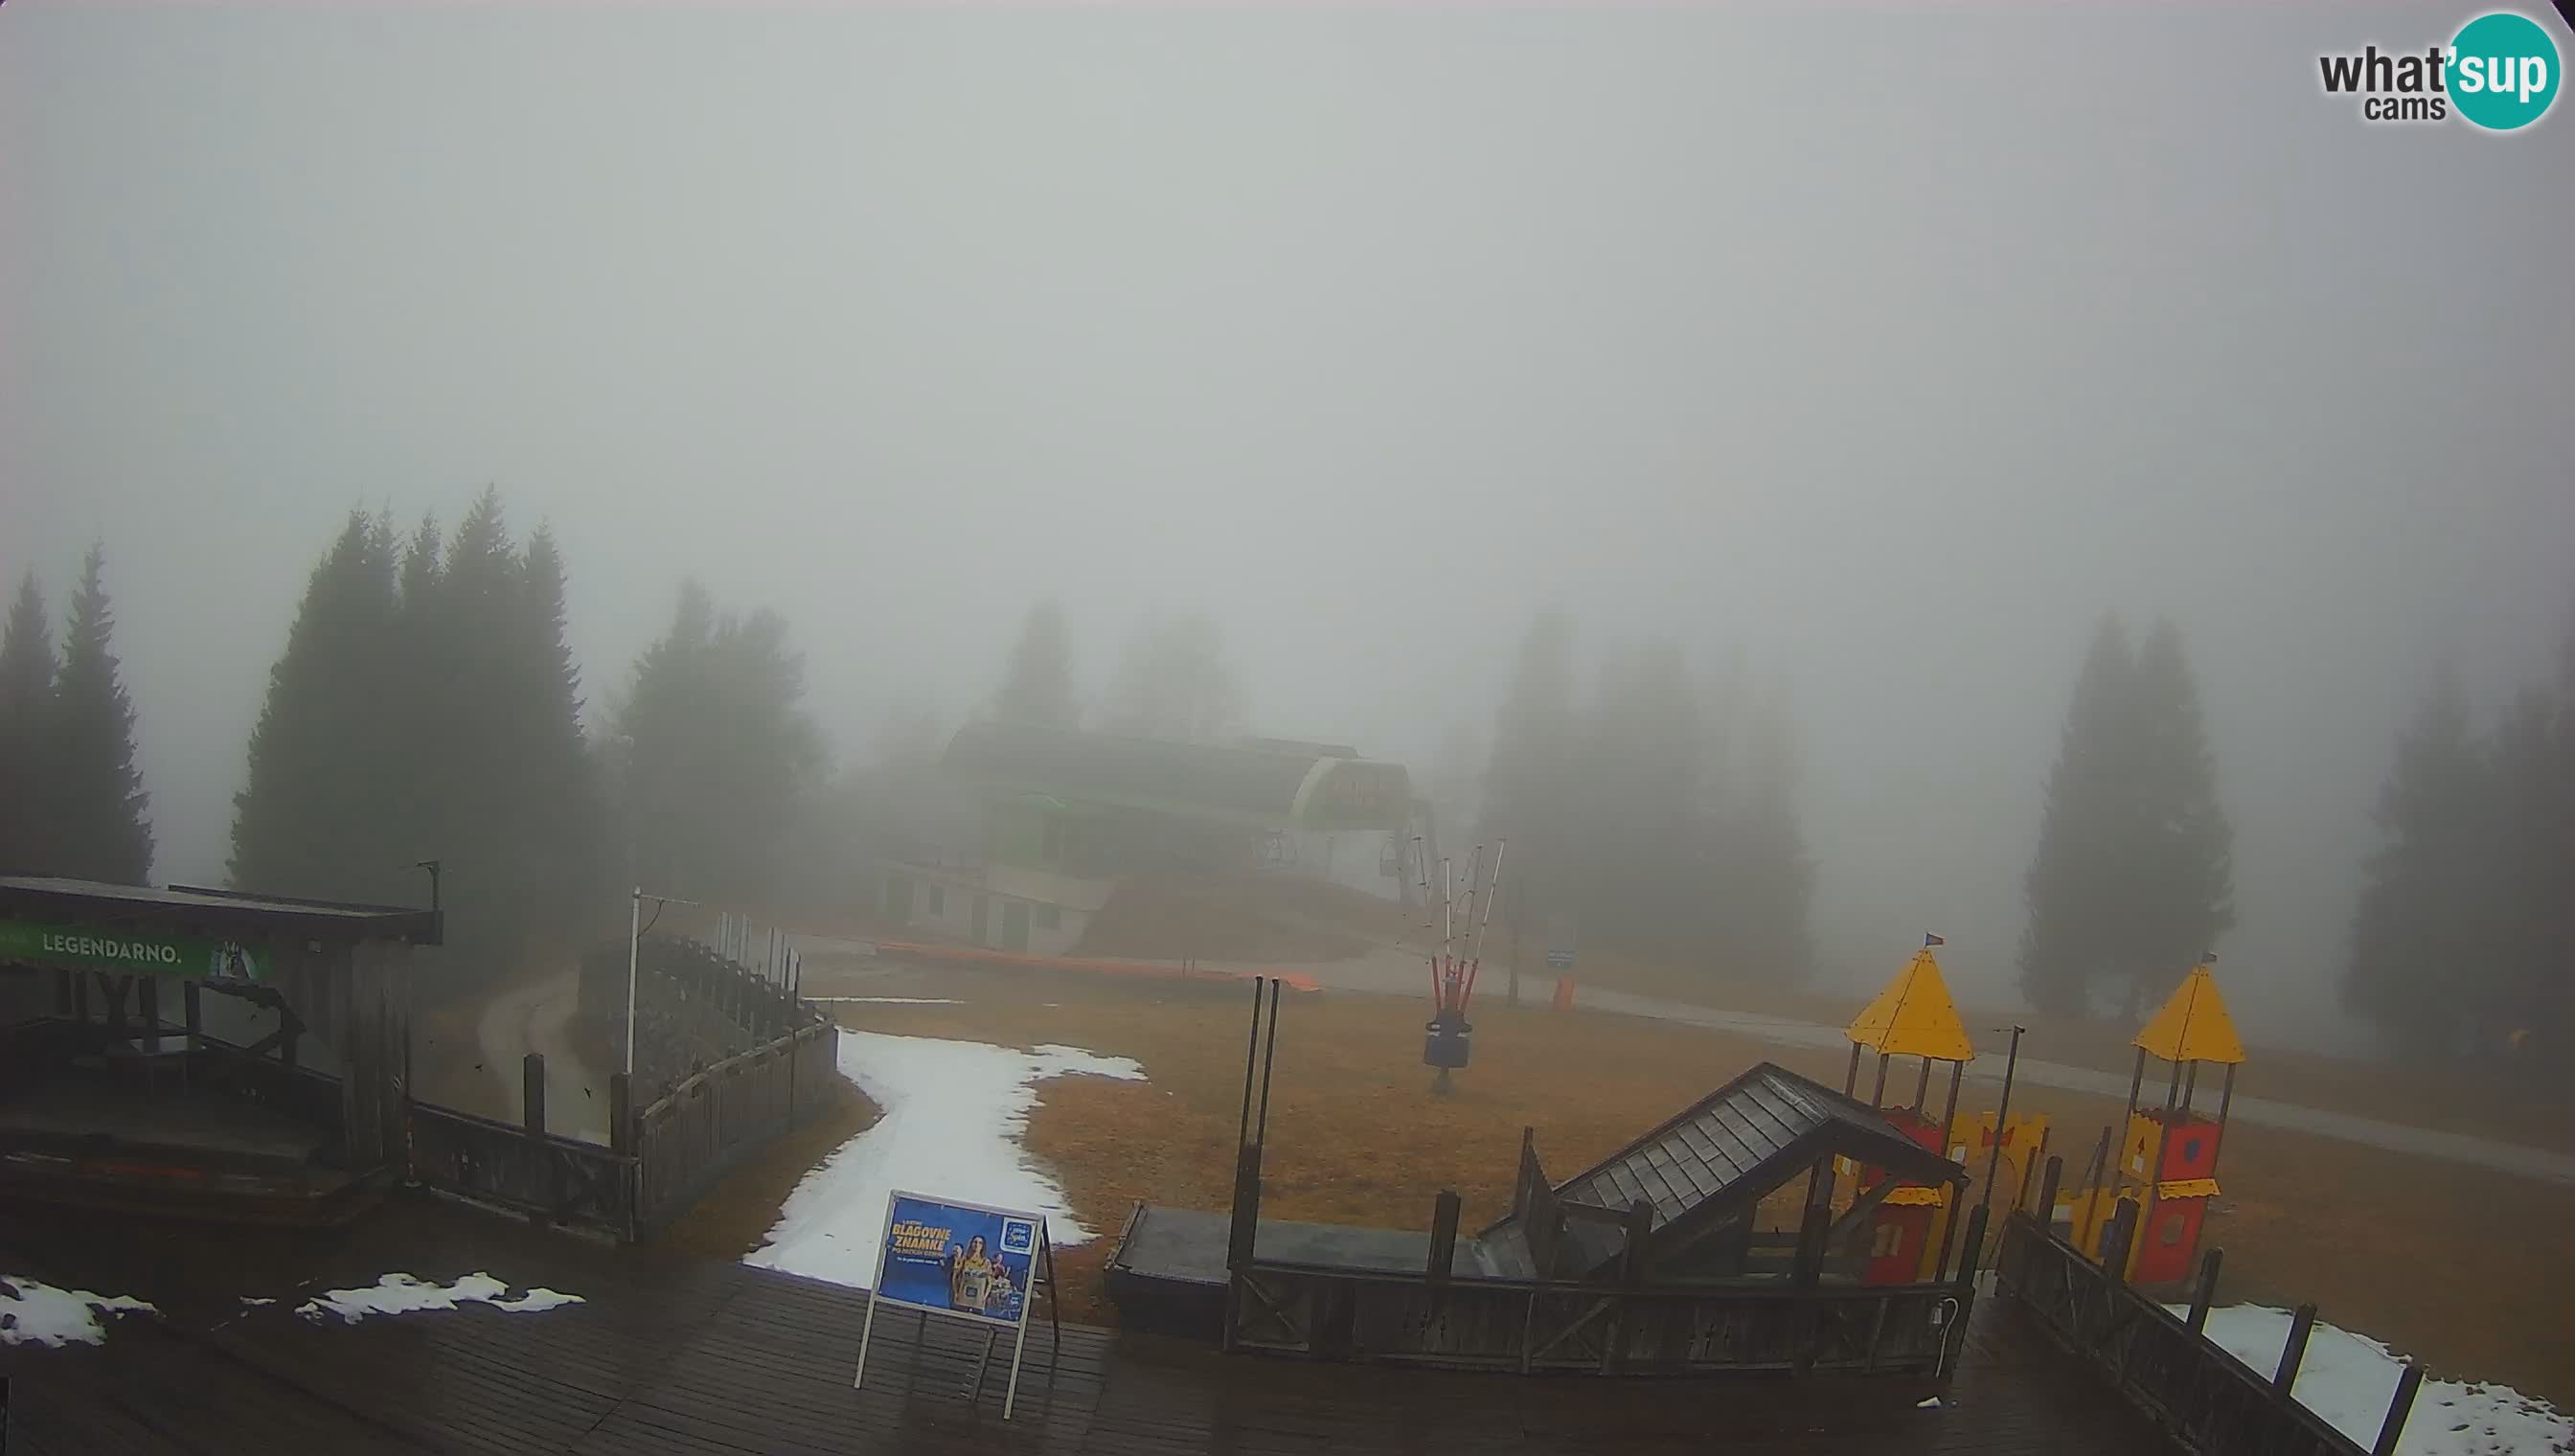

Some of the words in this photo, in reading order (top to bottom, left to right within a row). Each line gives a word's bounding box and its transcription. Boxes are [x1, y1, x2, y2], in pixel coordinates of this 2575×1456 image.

[43, 933, 182, 964] LEGENDARNO.
[892, 1223, 951, 1240] BLAGOVNE
[895, 1236, 946, 1251] ZNAMKE
